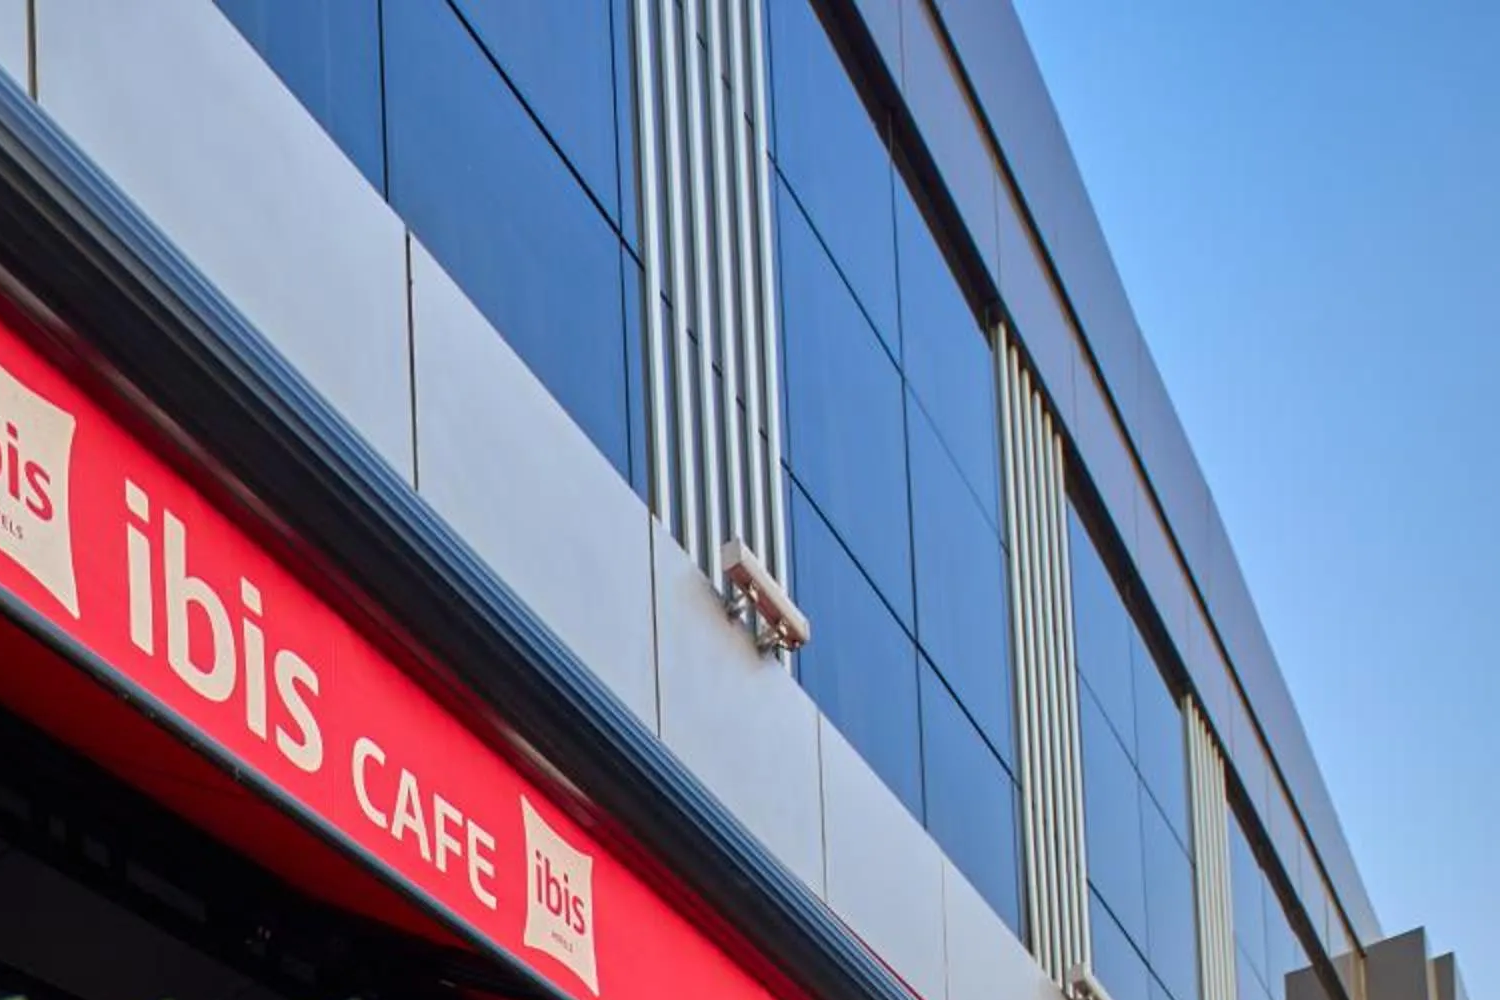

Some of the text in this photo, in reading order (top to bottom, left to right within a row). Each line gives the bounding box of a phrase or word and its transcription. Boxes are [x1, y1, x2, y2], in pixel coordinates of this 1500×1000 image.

[125, 479, 497, 910] ibis CAFE
[535, 850, 585, 935] ibis
